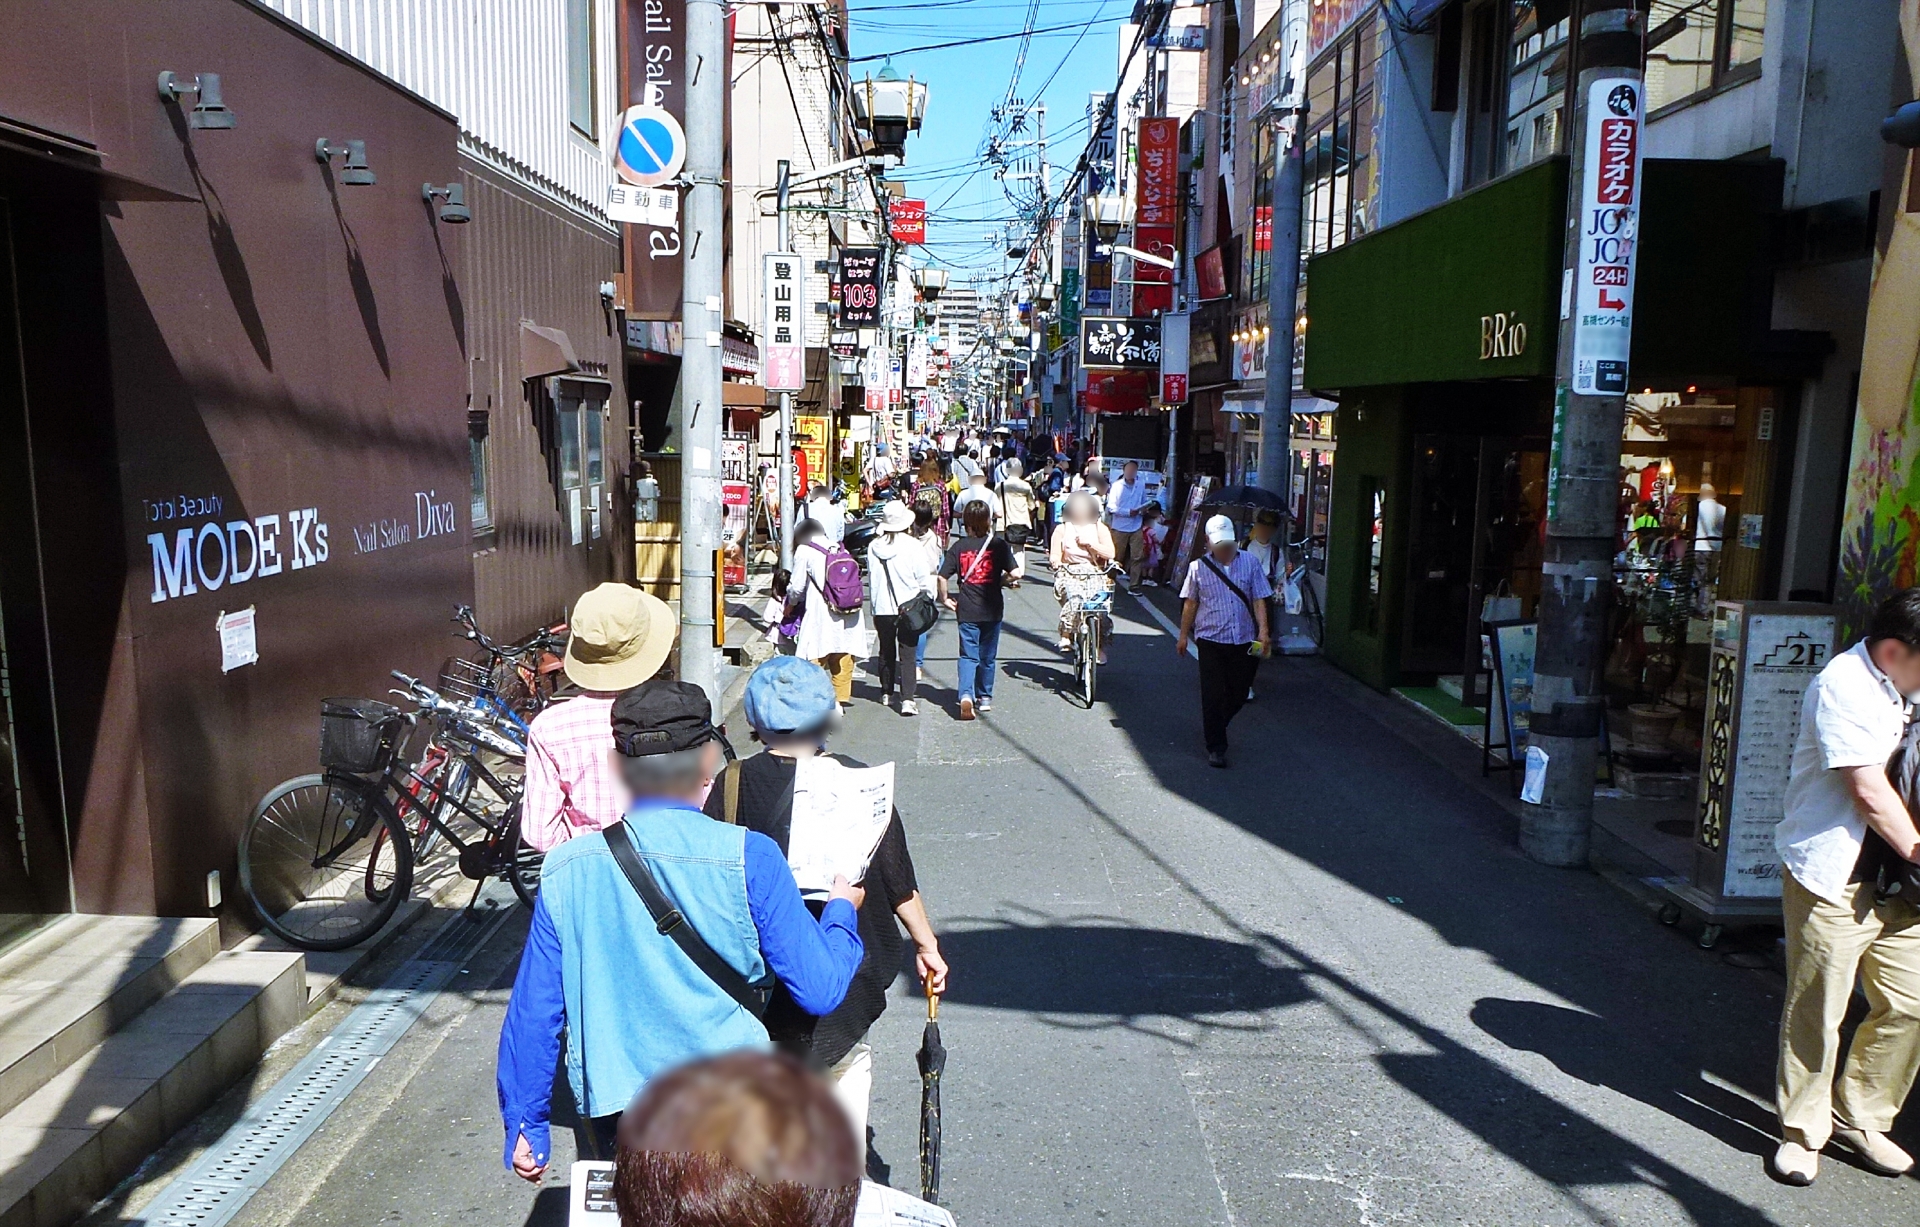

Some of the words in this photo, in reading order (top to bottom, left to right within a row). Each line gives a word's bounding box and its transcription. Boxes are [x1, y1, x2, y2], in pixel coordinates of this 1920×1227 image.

[1603, 121, 1633, 201] カラオケ
[610, 187, 674, 212] 自動車
[1594, 268, 1627, 284] 24H
[775, 262, 792, 343] 登山用品
[843, 283, 877, 308] 103
[1479, 311, 1527, 359] BRio
[891, 361, 899, 372] P
[179, 494, 224, 521] Beauty
[353, 526, 378, 556] Nail
[380, 518, 411, 549] Salon
[414, 489, 457, 540] Diva
[147, 514, 282, 604] MODE
[288, 507, 329, 570] K's
[1788, 643, 1826, 666] 2F
